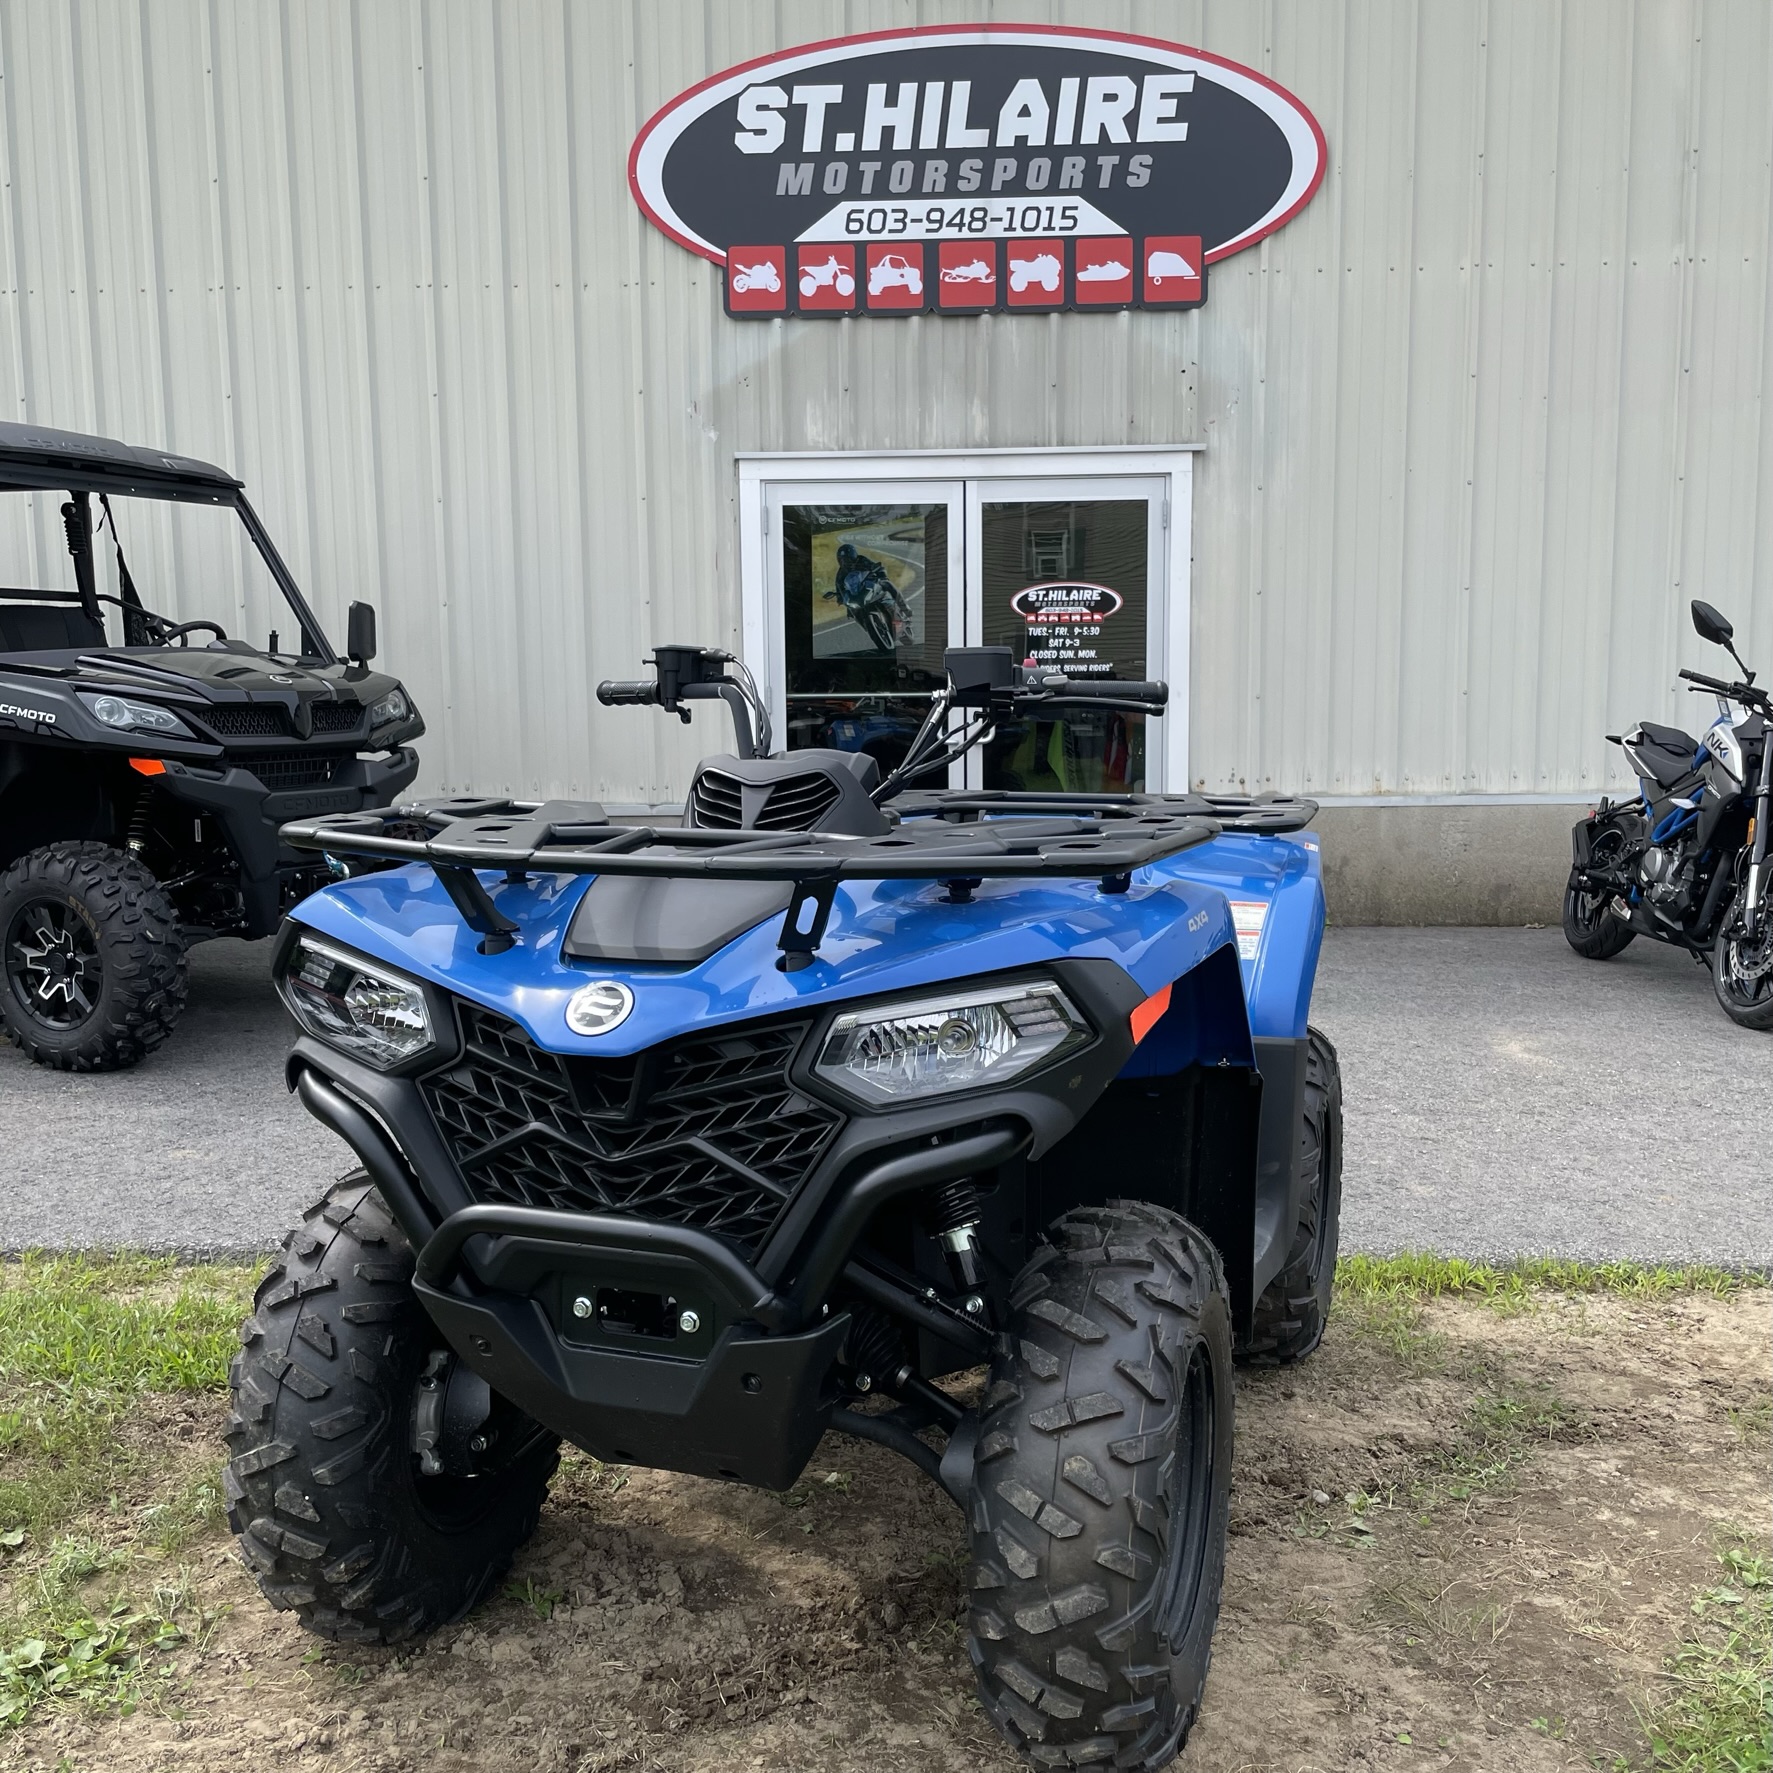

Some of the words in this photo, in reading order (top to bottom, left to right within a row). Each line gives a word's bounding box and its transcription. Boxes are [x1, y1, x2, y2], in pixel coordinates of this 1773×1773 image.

[734, 73, 1195, 154] ST.HILAIRE
[776, 154, 1154, 197] MOTORSPORTS
[844, 206, 1079, 234] 603-948-1015
[1028, 590, 1101, 601] ST.HILAIRE
[1055, 627, 1069, 636] FRI.
[1048, 639, 1064, 648] SAT
[1065, 639, 1080, 647] 9-3
[1029, 650, 1058, 659] CLOSED
[1058, 650, 1076, 659] SUN.
[1077, 650, 1098, 659] MON.
[1063, 664, 1088, 672] SERVING
[0, 703, 56, 724] CFMOTO
[1706, 732, 1729, 759] NK
[283, 794, 350, 810] CFMOTO
